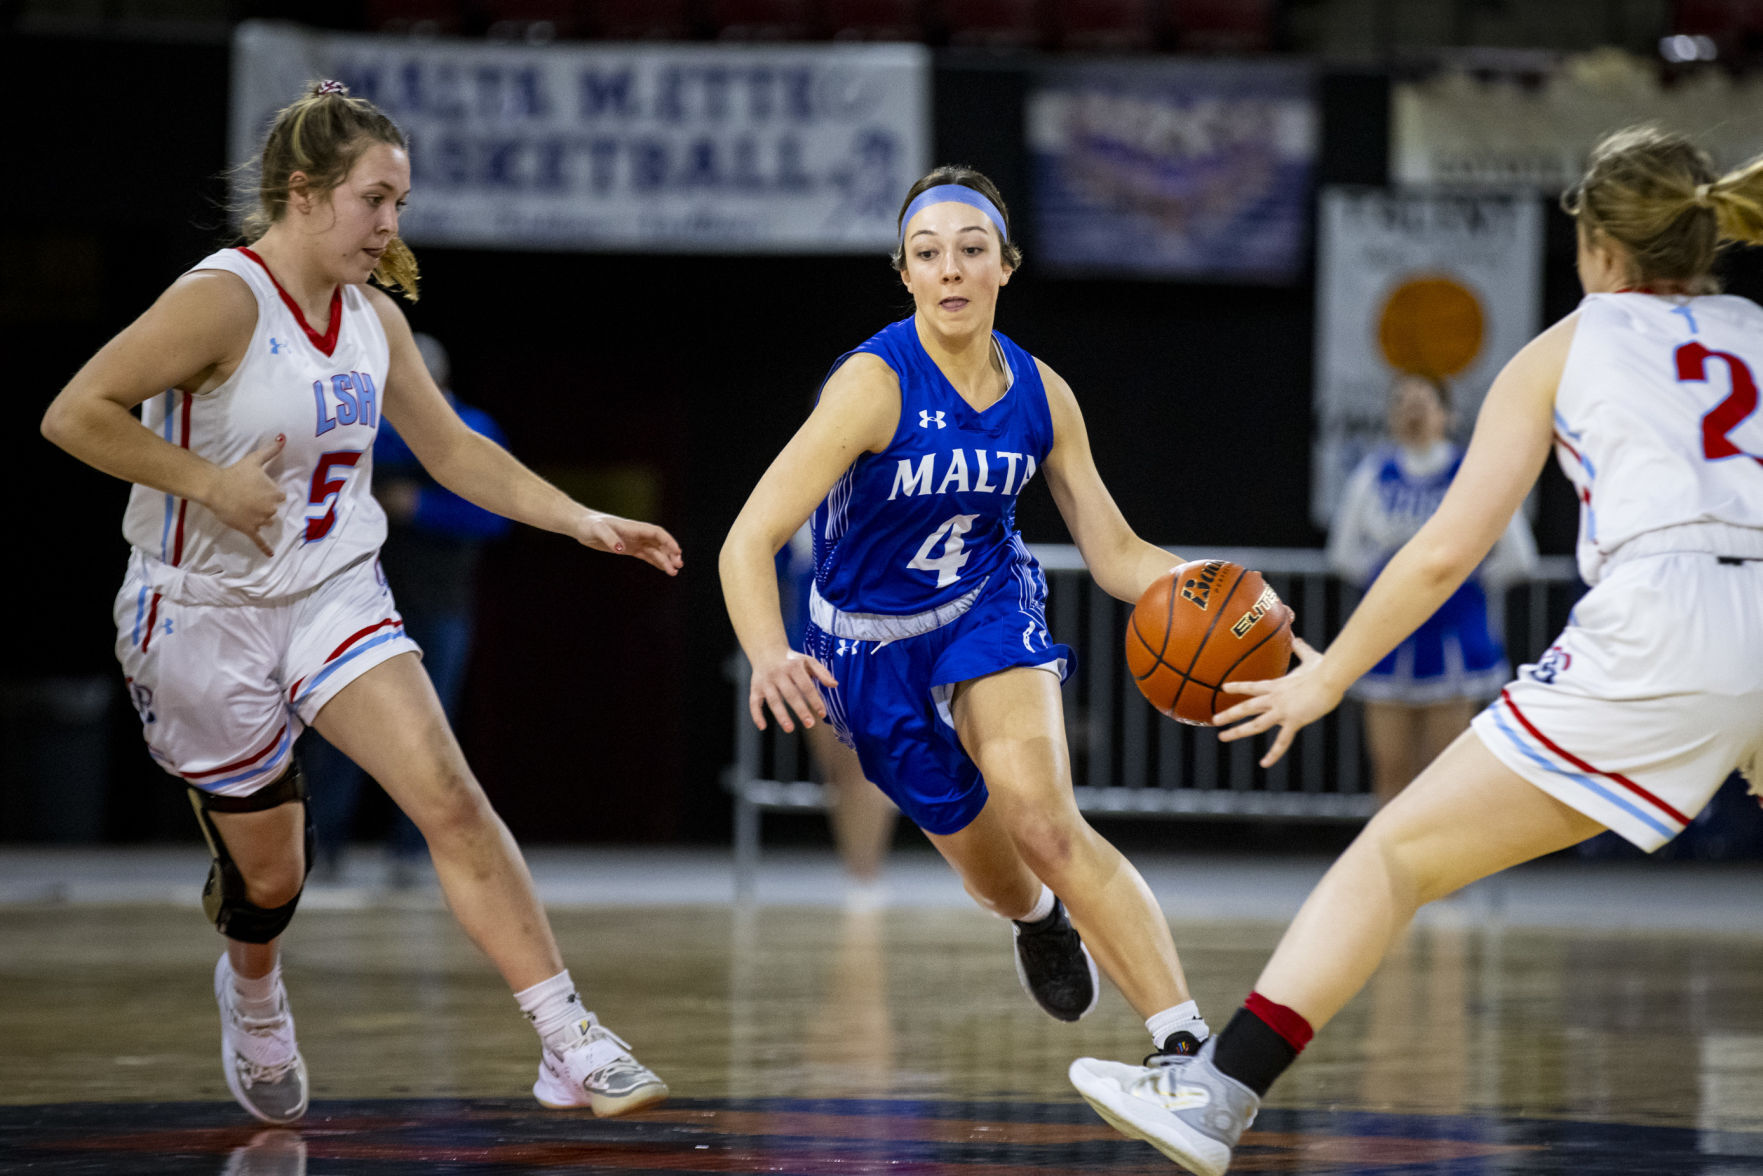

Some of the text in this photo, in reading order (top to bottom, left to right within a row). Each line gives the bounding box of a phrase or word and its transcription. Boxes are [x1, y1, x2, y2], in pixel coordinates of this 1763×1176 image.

[313, 371, 376, 438] LSH
[1673, 339, 1763, 463] 2
[304, 450, 362, 544] 5
[906, 513, 981, 589] 4
